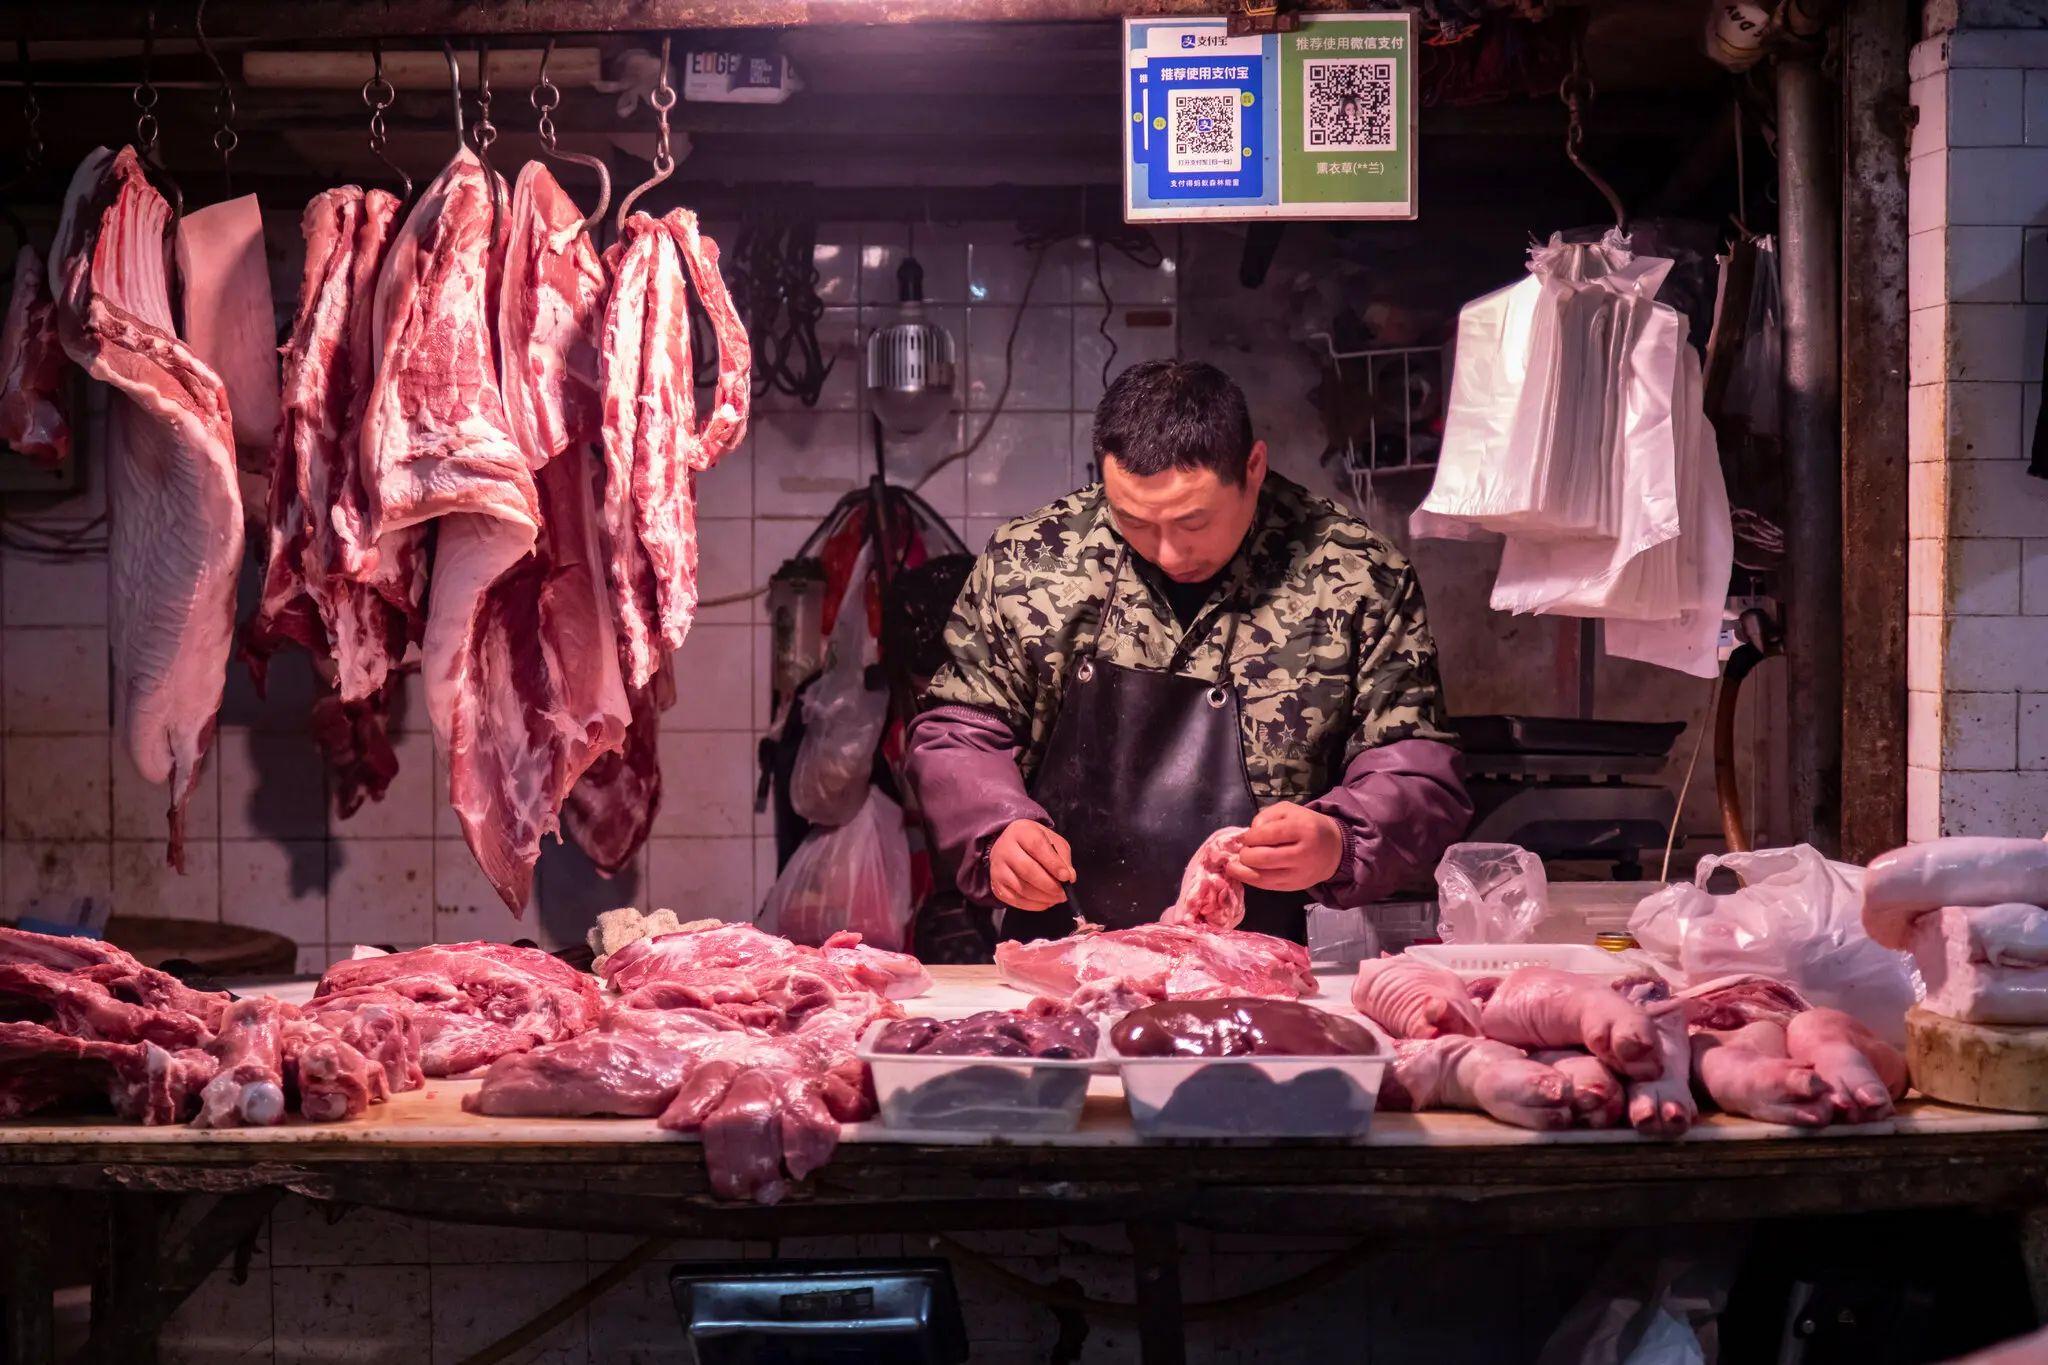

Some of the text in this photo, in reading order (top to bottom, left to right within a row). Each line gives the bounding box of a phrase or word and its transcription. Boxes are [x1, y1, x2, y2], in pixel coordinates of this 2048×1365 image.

[1197, 35, 1228, 47] 支付宝
[1295, 36, 1404, 51] 推荐使用微信支付
[1161, 66, 1249, 81] 推荐使用支付宝
